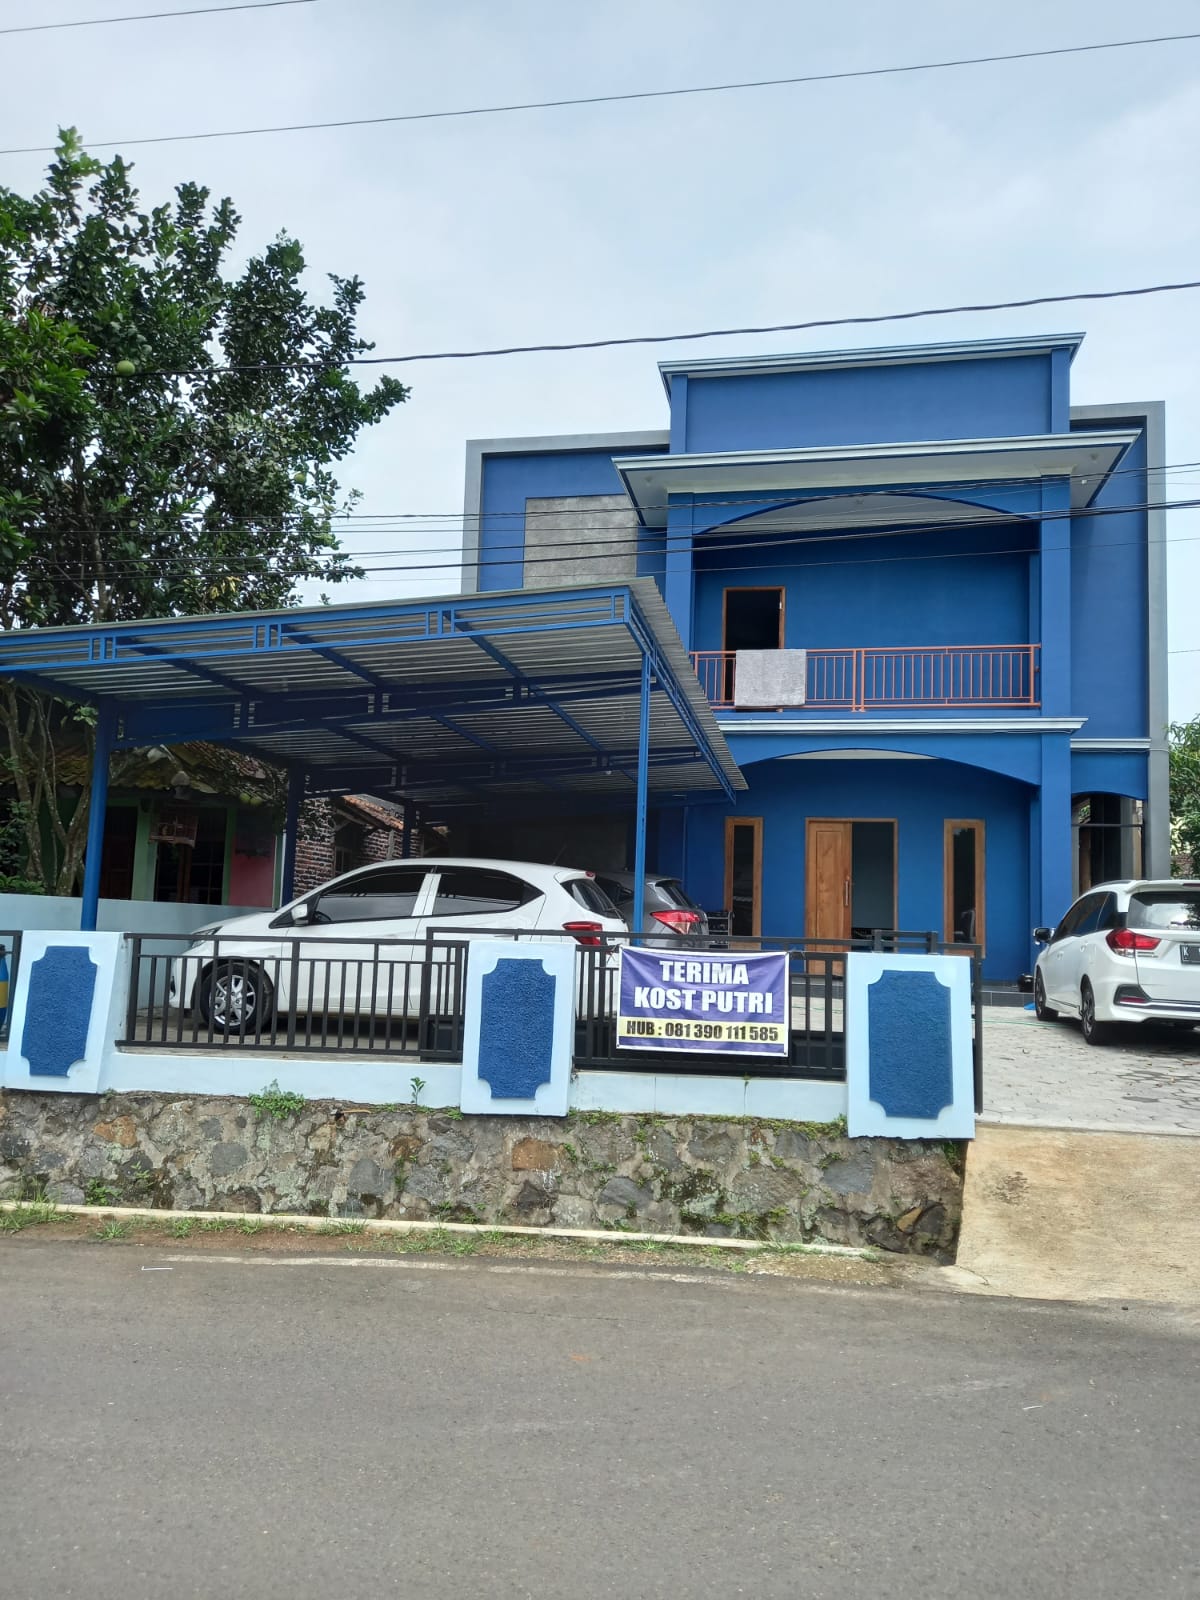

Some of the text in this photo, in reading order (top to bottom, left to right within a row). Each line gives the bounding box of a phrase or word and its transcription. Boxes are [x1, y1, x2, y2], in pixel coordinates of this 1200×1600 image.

[659, 960, 749, 985] TERIMA
[634, 986, 773, 1014] KOST PUTRI
[665, 1022, 691, 1038] 081
[694, 1024, 722, 1039] 390
[726, 1026, 746, 1040] 111
[750, 1026, 779, 1041] 585
